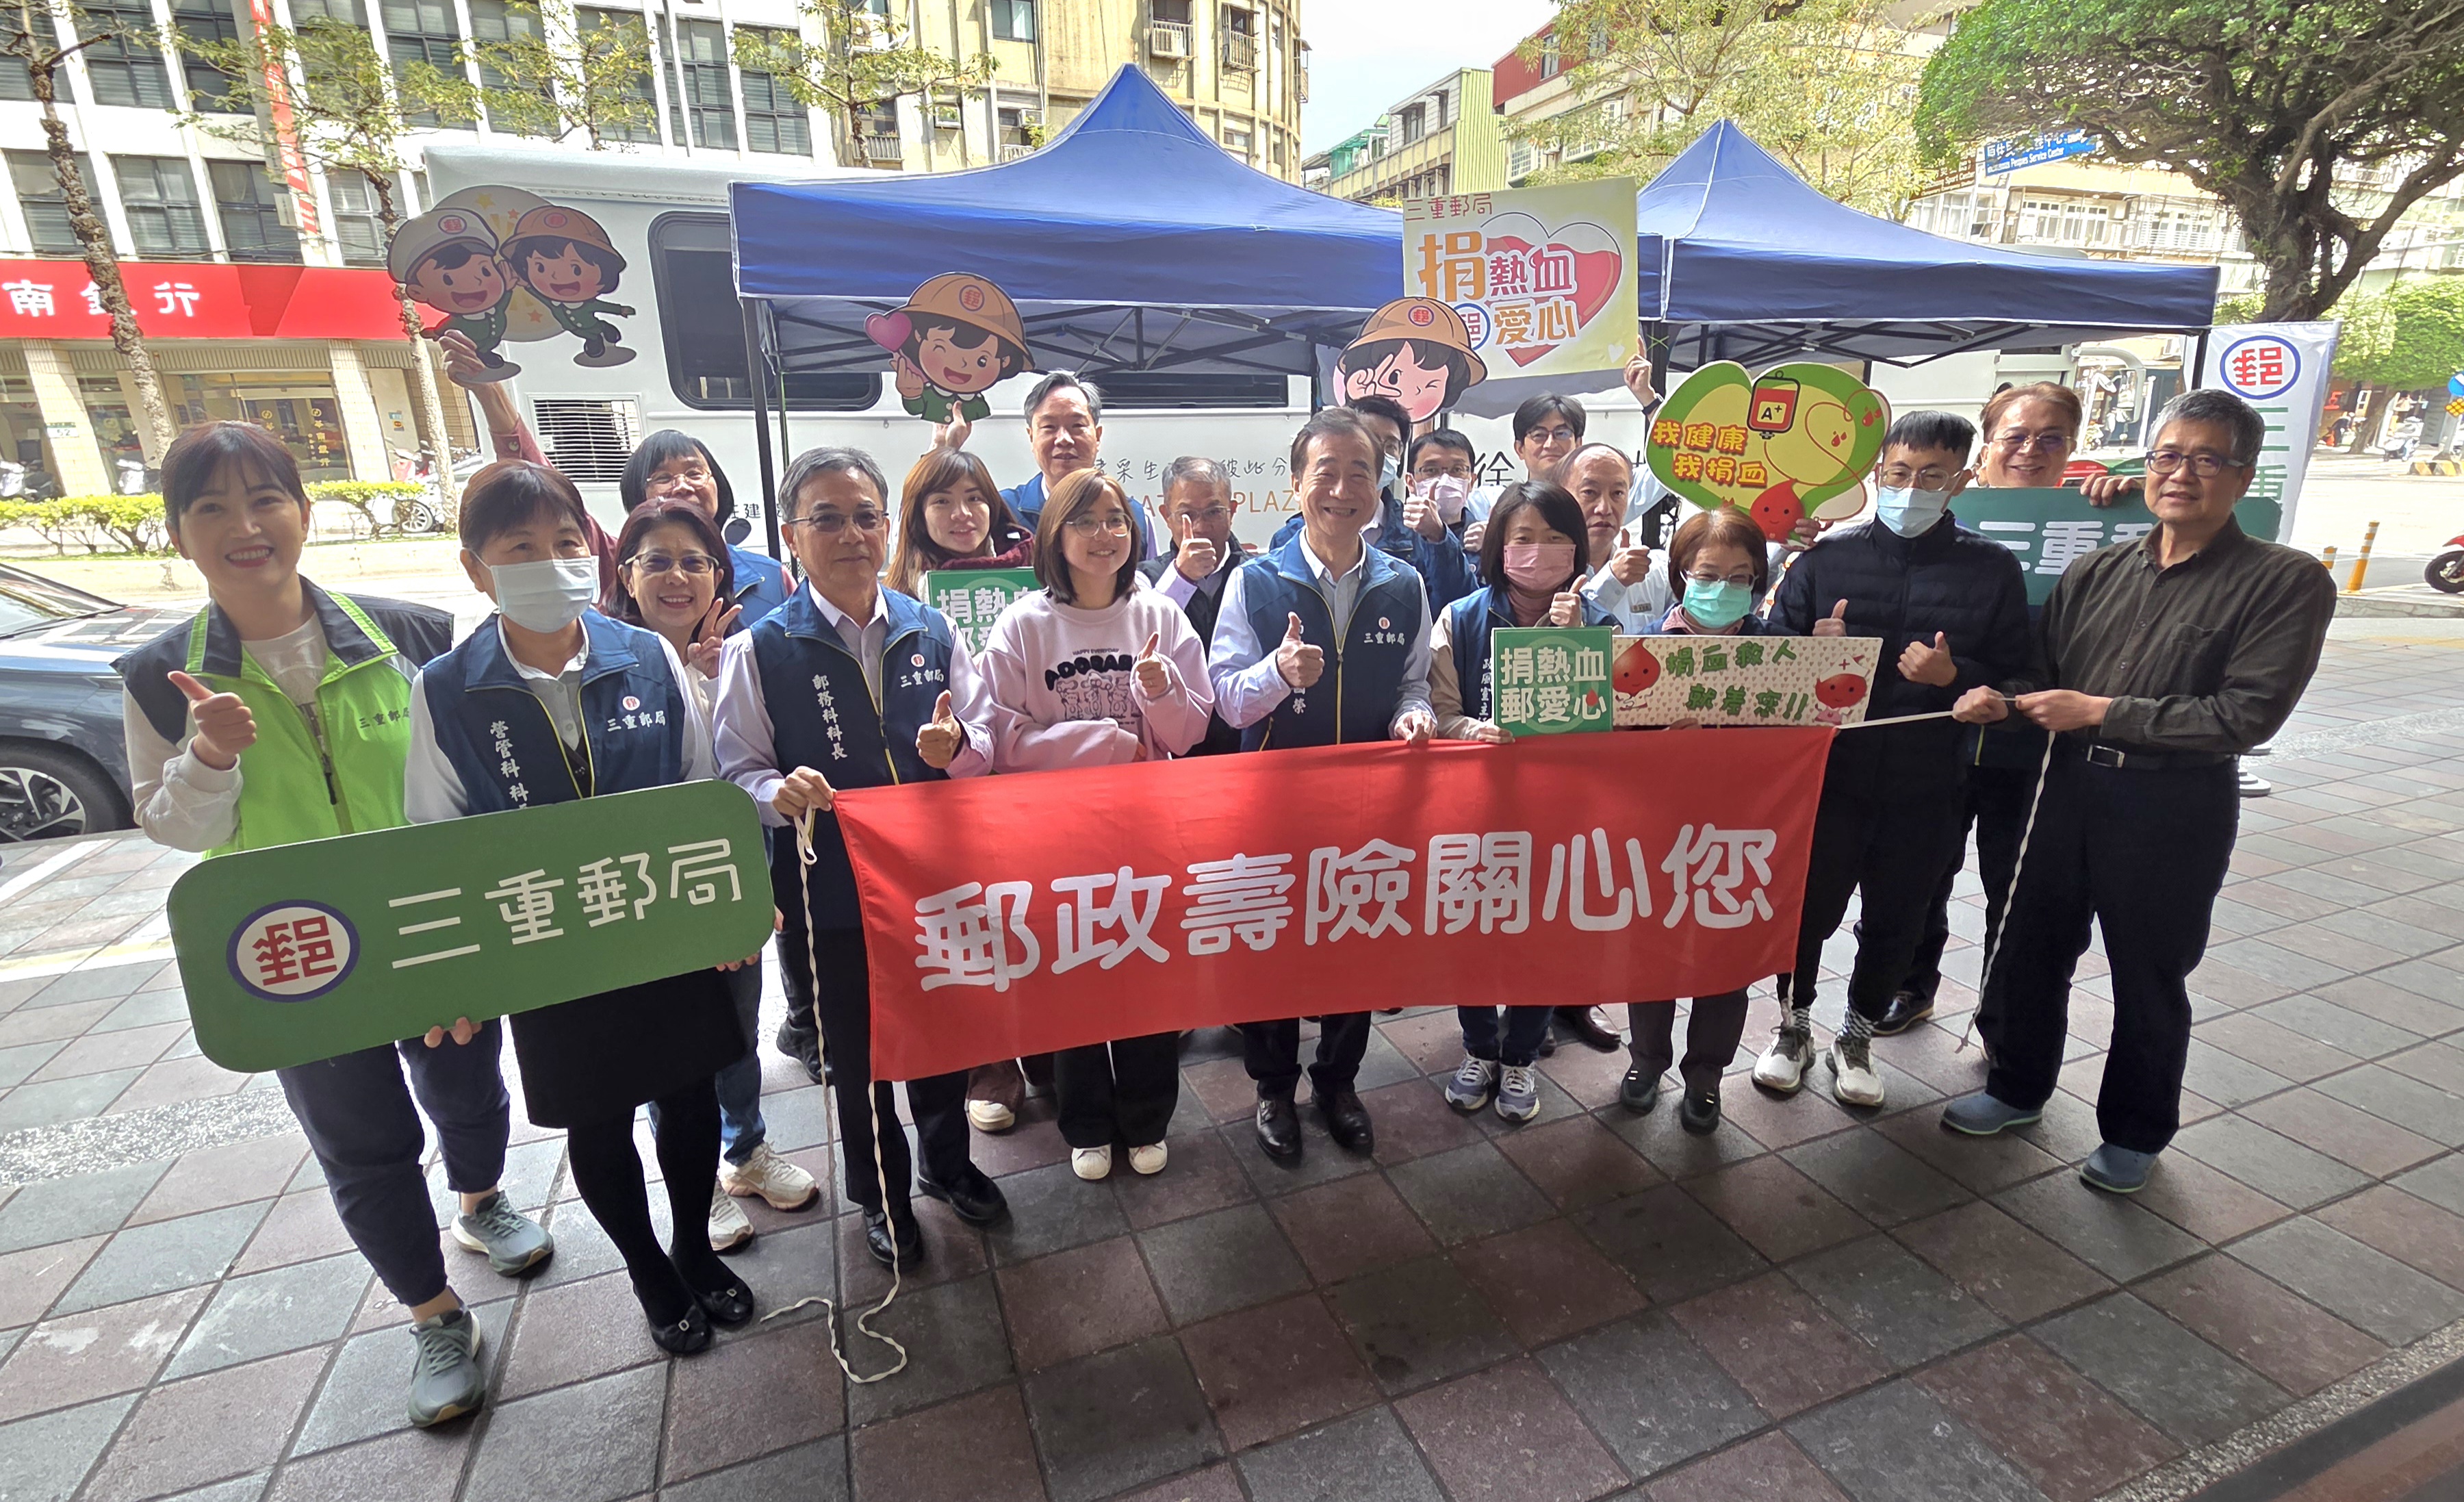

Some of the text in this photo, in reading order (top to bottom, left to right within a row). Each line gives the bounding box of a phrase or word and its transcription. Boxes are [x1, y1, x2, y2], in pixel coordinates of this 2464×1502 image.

[2029, 151, 2047, 163] Service
[2048, 147, 2064, 158] Center
[1405, 193, 1493, 221] 三重郵局
[1417, 230, 1573, 303] 捐熱血
[1652, 420, 1749, 454] 我健康
[1674, 455, 1768, 485] 我捐血
[1233, 489, 1302, 513] PLAZ
[1363, 631, 1405, 646] 三重郵局
[1044, 654, 1139, 691] ADORAB
[1500, 646, 1607, 685] 捐熱血
[1665, 638, 1797, 678] 捐血救人
[900, 668, 945, 688] 三重郵局
[607, 710, 667, 733] 三重郵局
[811, 674, 848, 761] 郵務科科長
[1500, 685, 1607, 724] 郵愛心
[489, 720, 529, 809] 營管科科
[389, 838, 742, 969] 三重郵局
[914, 823, 1778, 993] 郵政壽險關心您
